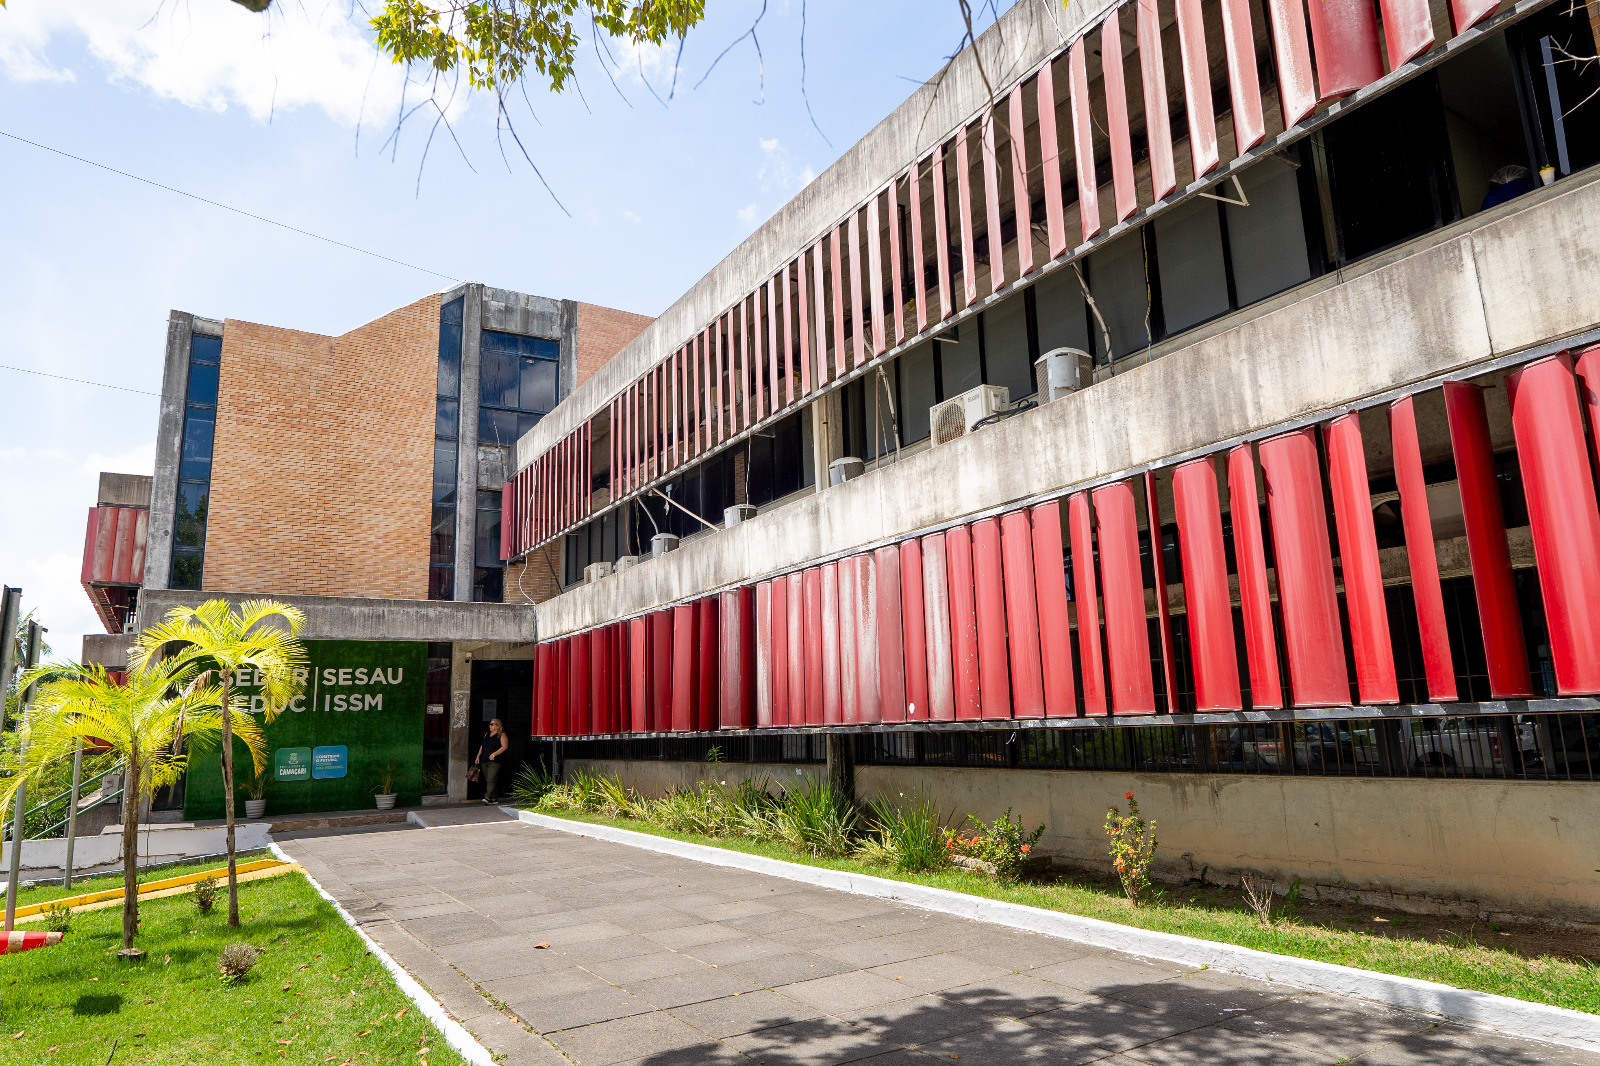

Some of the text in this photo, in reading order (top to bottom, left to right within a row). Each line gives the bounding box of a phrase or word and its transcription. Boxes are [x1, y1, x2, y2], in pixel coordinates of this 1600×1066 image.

[322, 667, 403, 686] SESAU
[216, 693, 383, 713] EDUC ISSM
[279, 768, 307, 776] CAMAÇARI
